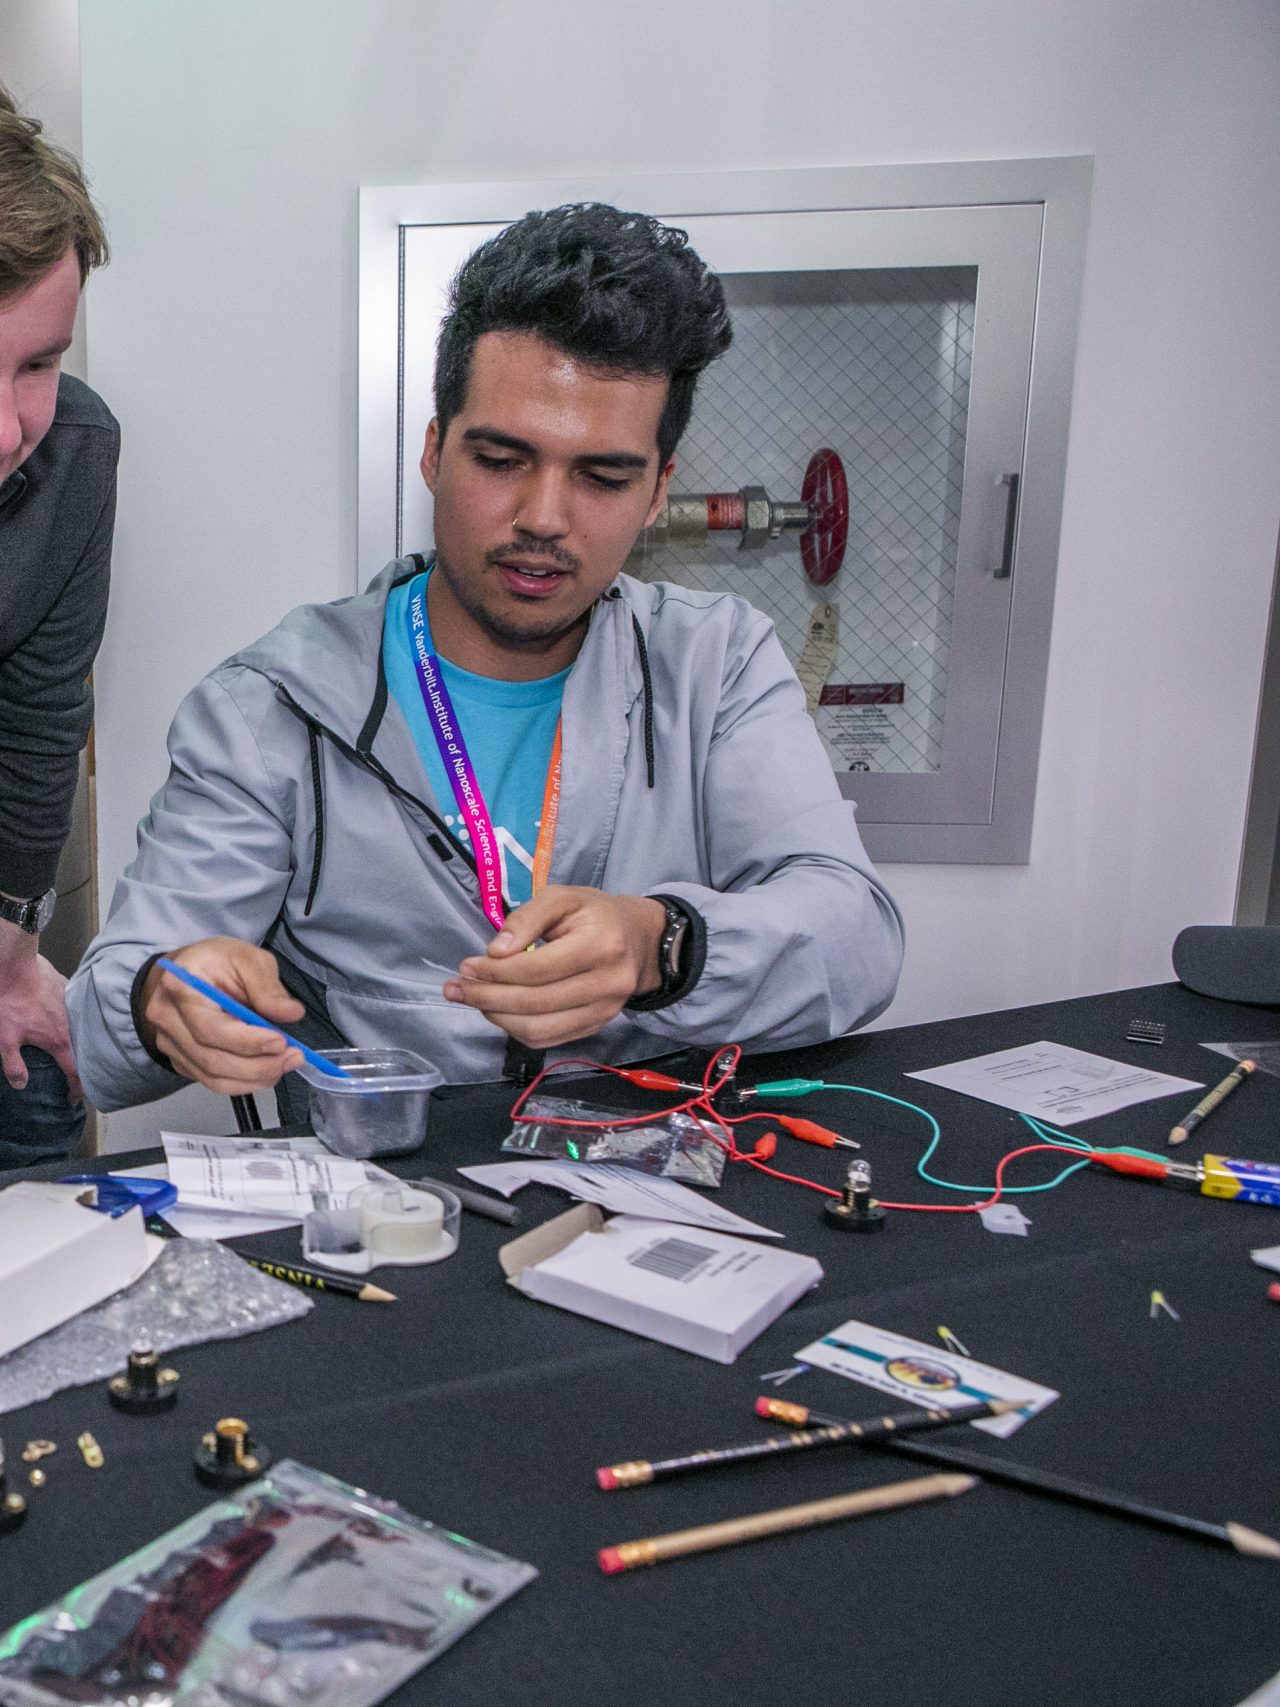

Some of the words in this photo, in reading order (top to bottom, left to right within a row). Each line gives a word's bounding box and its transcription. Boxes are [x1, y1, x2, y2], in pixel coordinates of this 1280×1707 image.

[410, 593, 425, 631] VINSE
[447, 742, 461, 756] of
[452, 757, 480, 817] Nanoscale
[474, 818, 492, 865] Science
[486, 869, 498, 892] and
